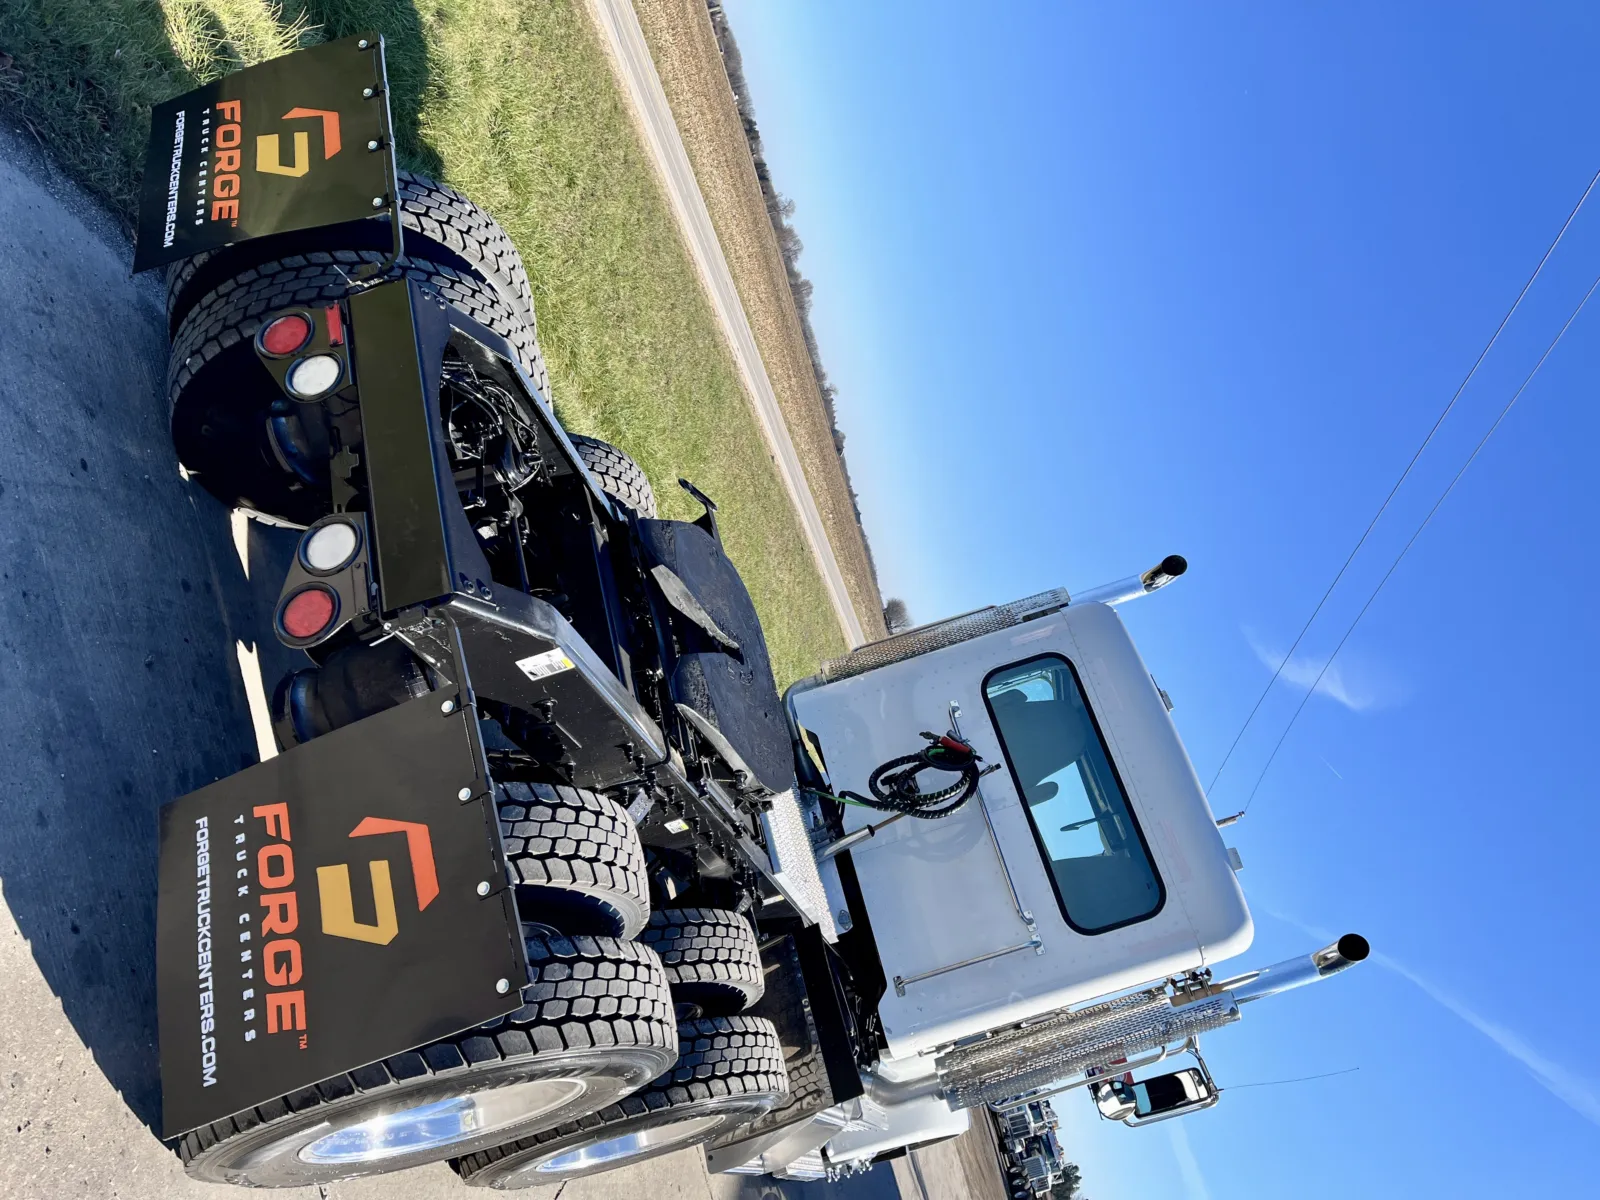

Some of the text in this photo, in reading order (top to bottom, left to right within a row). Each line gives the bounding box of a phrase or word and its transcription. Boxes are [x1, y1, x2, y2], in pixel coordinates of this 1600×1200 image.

[162, 110, 186, 248] FORGETRUCKCENTERS.COM
[195, 107, 210, 226] TRUCK CENTERS
[211, 99, 242, 221] FORGE
[194, 815, 217, 1088] FORGETRUCKCENTERS.COM
[233, 814, 257, 1042] TRUCK CENTERS
[252, 801, 307, 1034] FORGE
